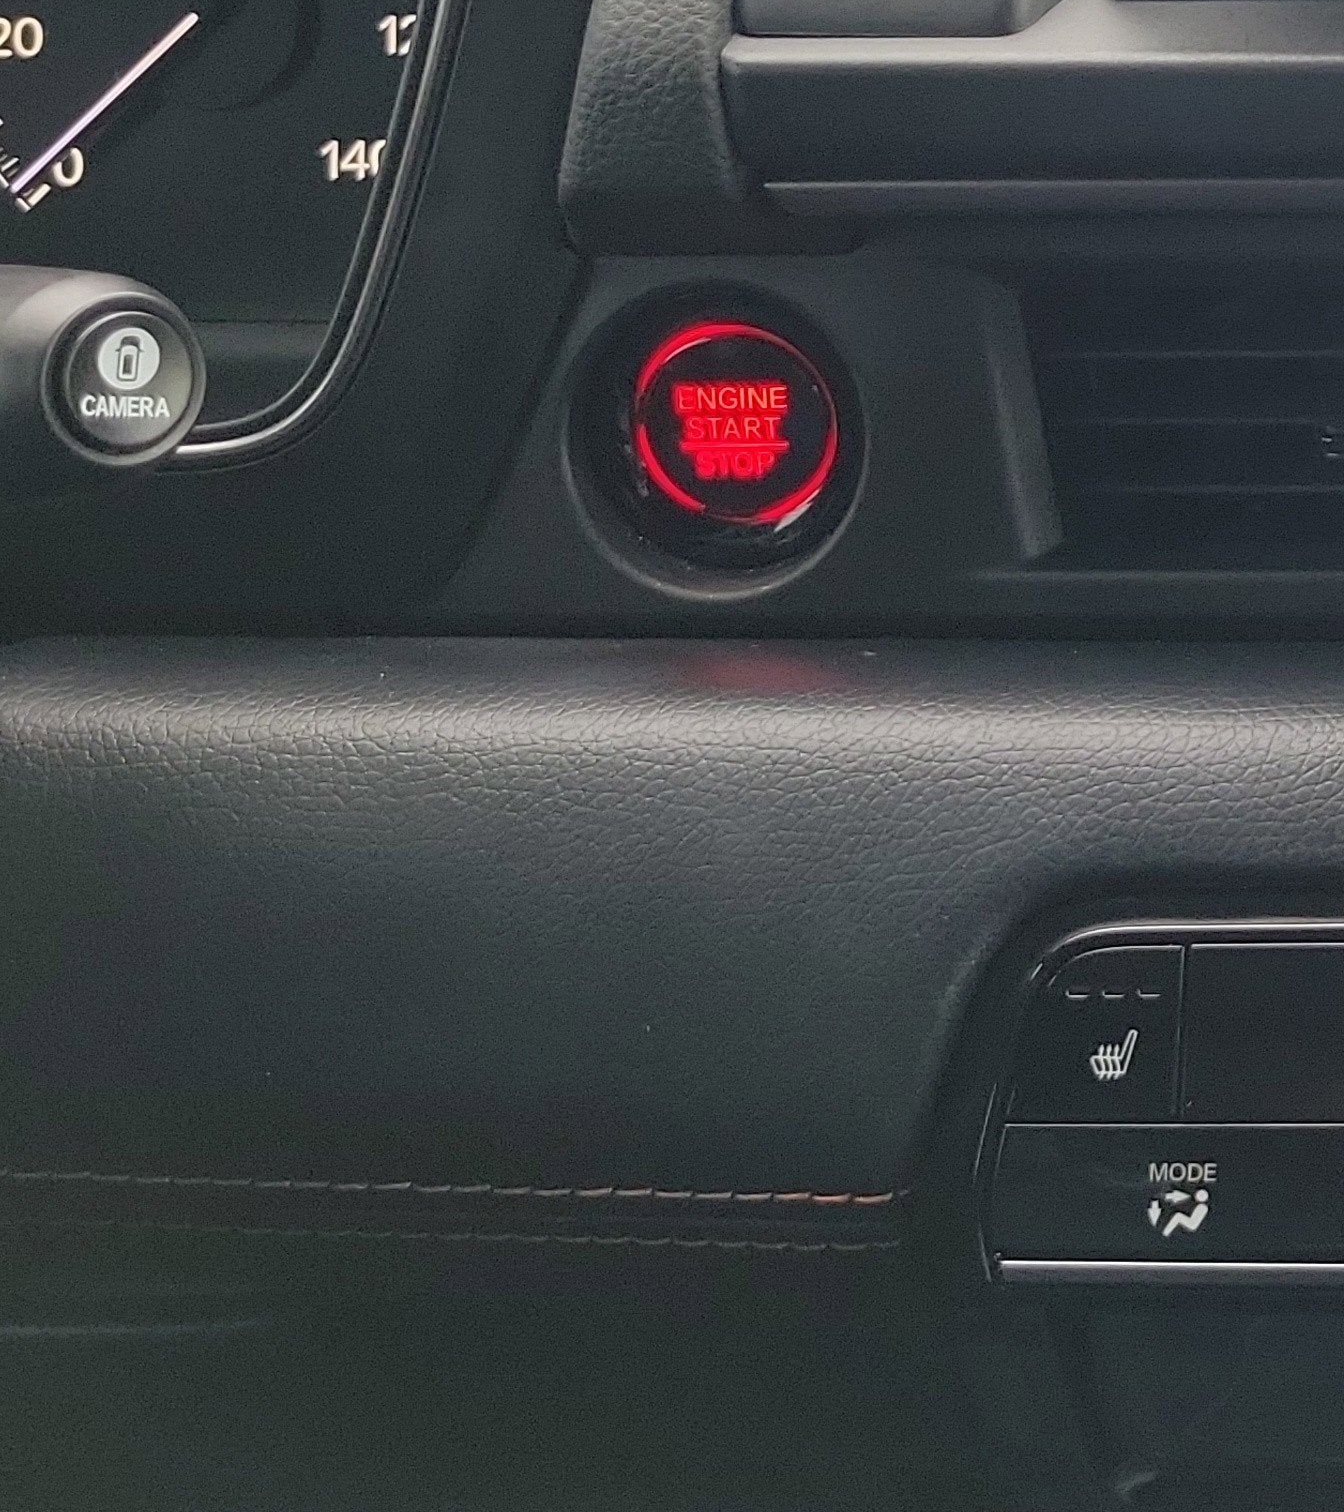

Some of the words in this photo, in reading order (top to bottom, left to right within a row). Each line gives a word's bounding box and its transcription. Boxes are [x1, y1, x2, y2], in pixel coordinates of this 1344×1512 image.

[377, 14, 417, 56] 12
[79, 394, 170, 419] CAMERA
[677, 385, 788, 410] ENGINE
[688, 416, 781, 440] START
[697, 451, 775, 476] STOP
[1149, 1162, 1218, 1183] MODE
